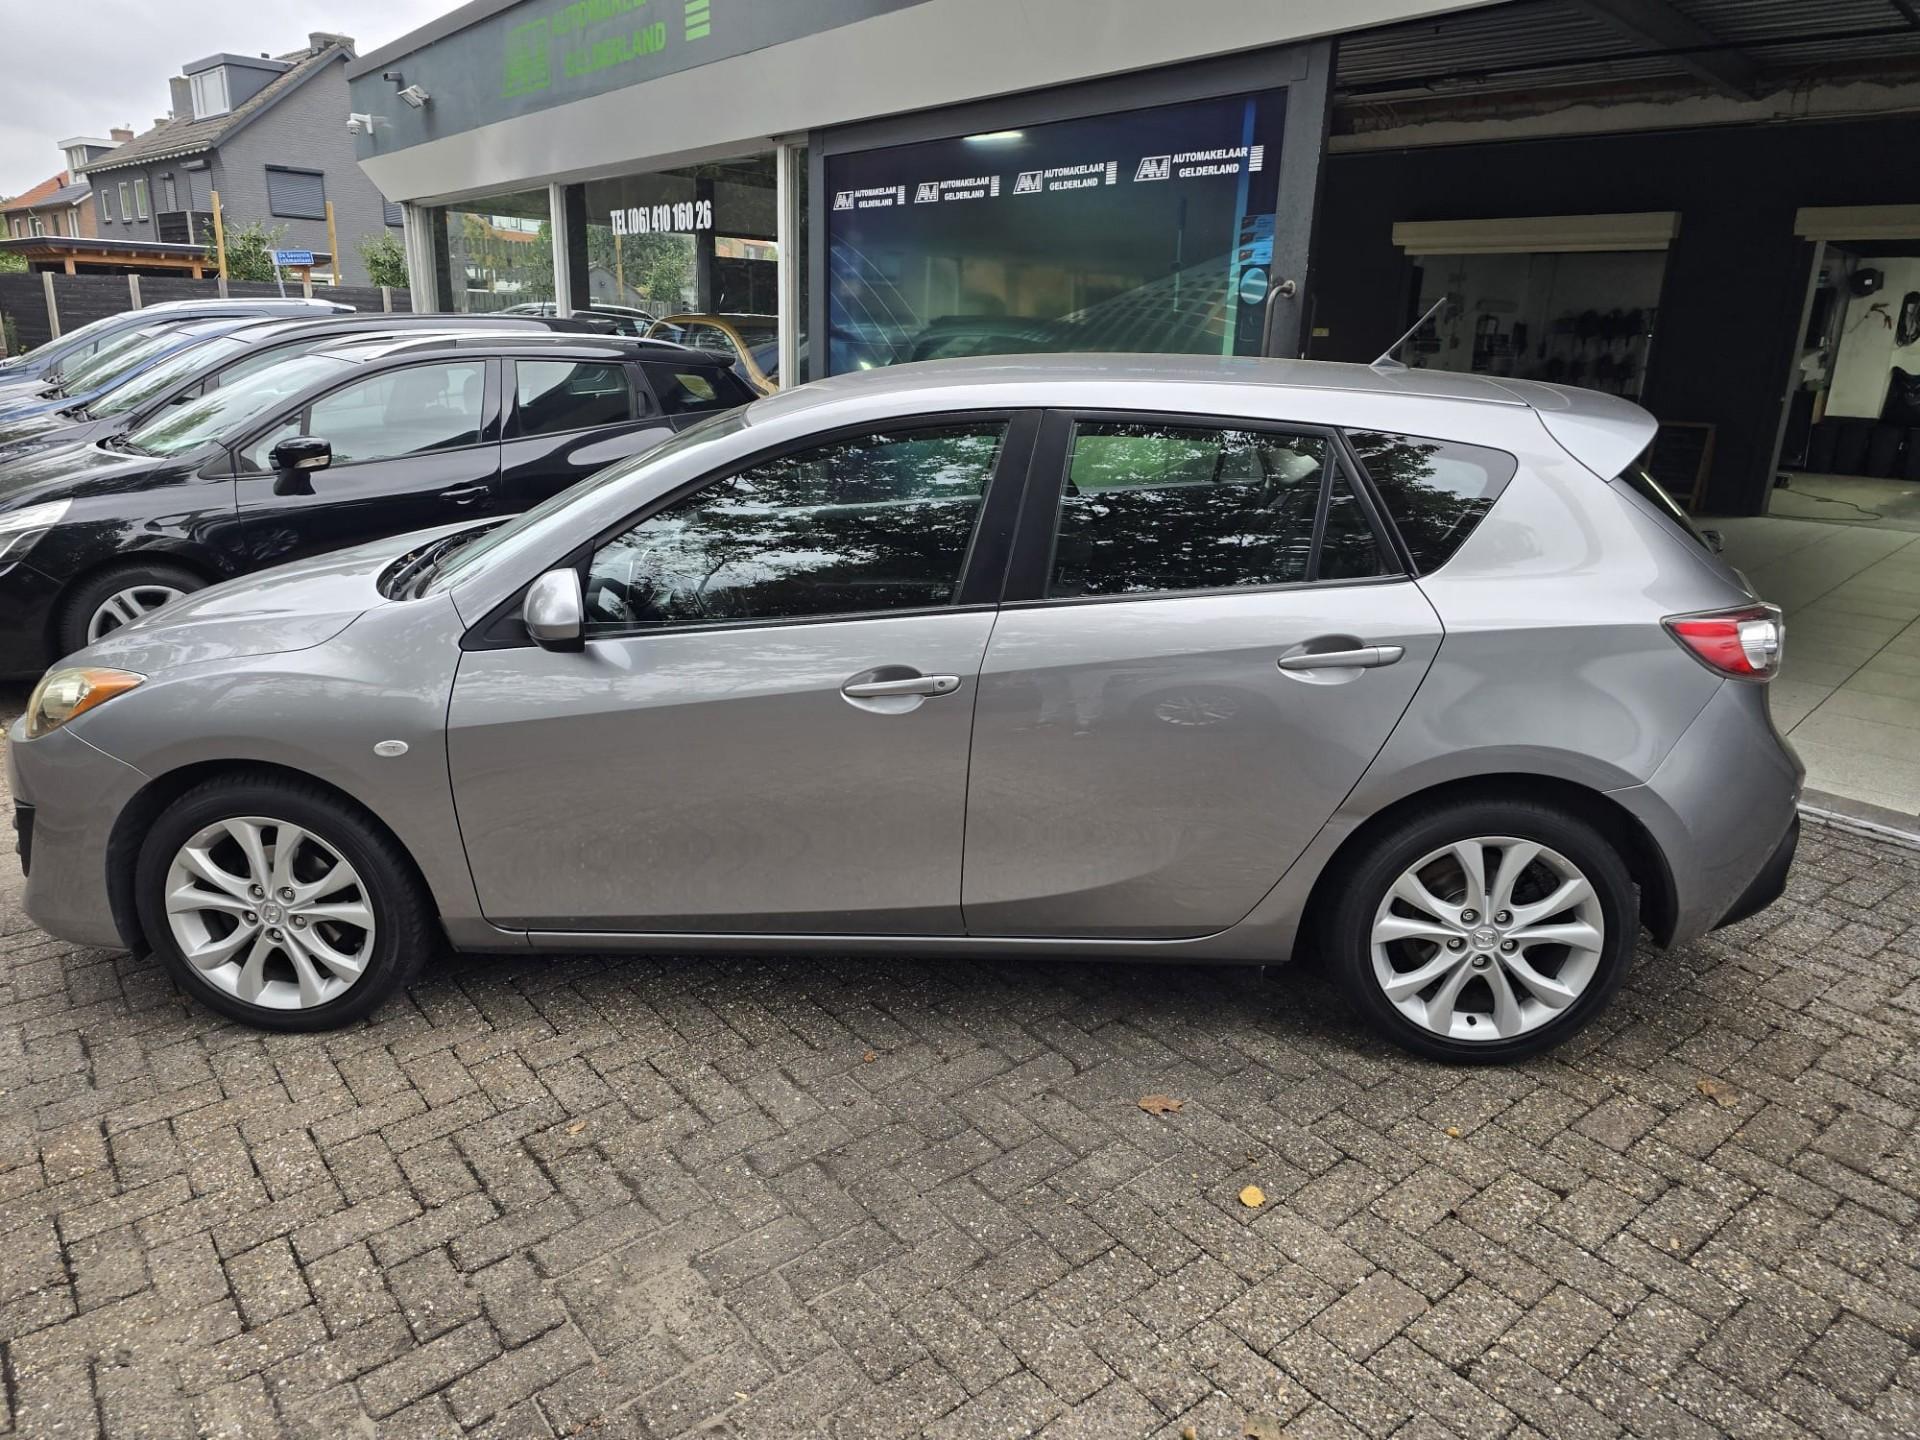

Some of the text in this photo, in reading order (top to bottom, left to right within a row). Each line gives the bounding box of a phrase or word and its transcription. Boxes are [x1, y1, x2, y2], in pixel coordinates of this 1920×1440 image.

[1172, 147, 1248, 164] AUTOMAKELAAR
[1044, 163, 1105, 179] AUTOMAKELAAR
[1179, 163, 1240, 178] GELDERLAND
[940, 177, 990, 189] AUTOMAKELAAR
[1049, 178, 1098, 191] GELDERLAND
[855, 186, 897, 198] AUTOMAKELAAR
[944, 190, 985, 201] GELDERLAND
[858, 198, 893, 209] GELDERLAND
[610, 200, 712, 235] TEL (06) 410 160 26
